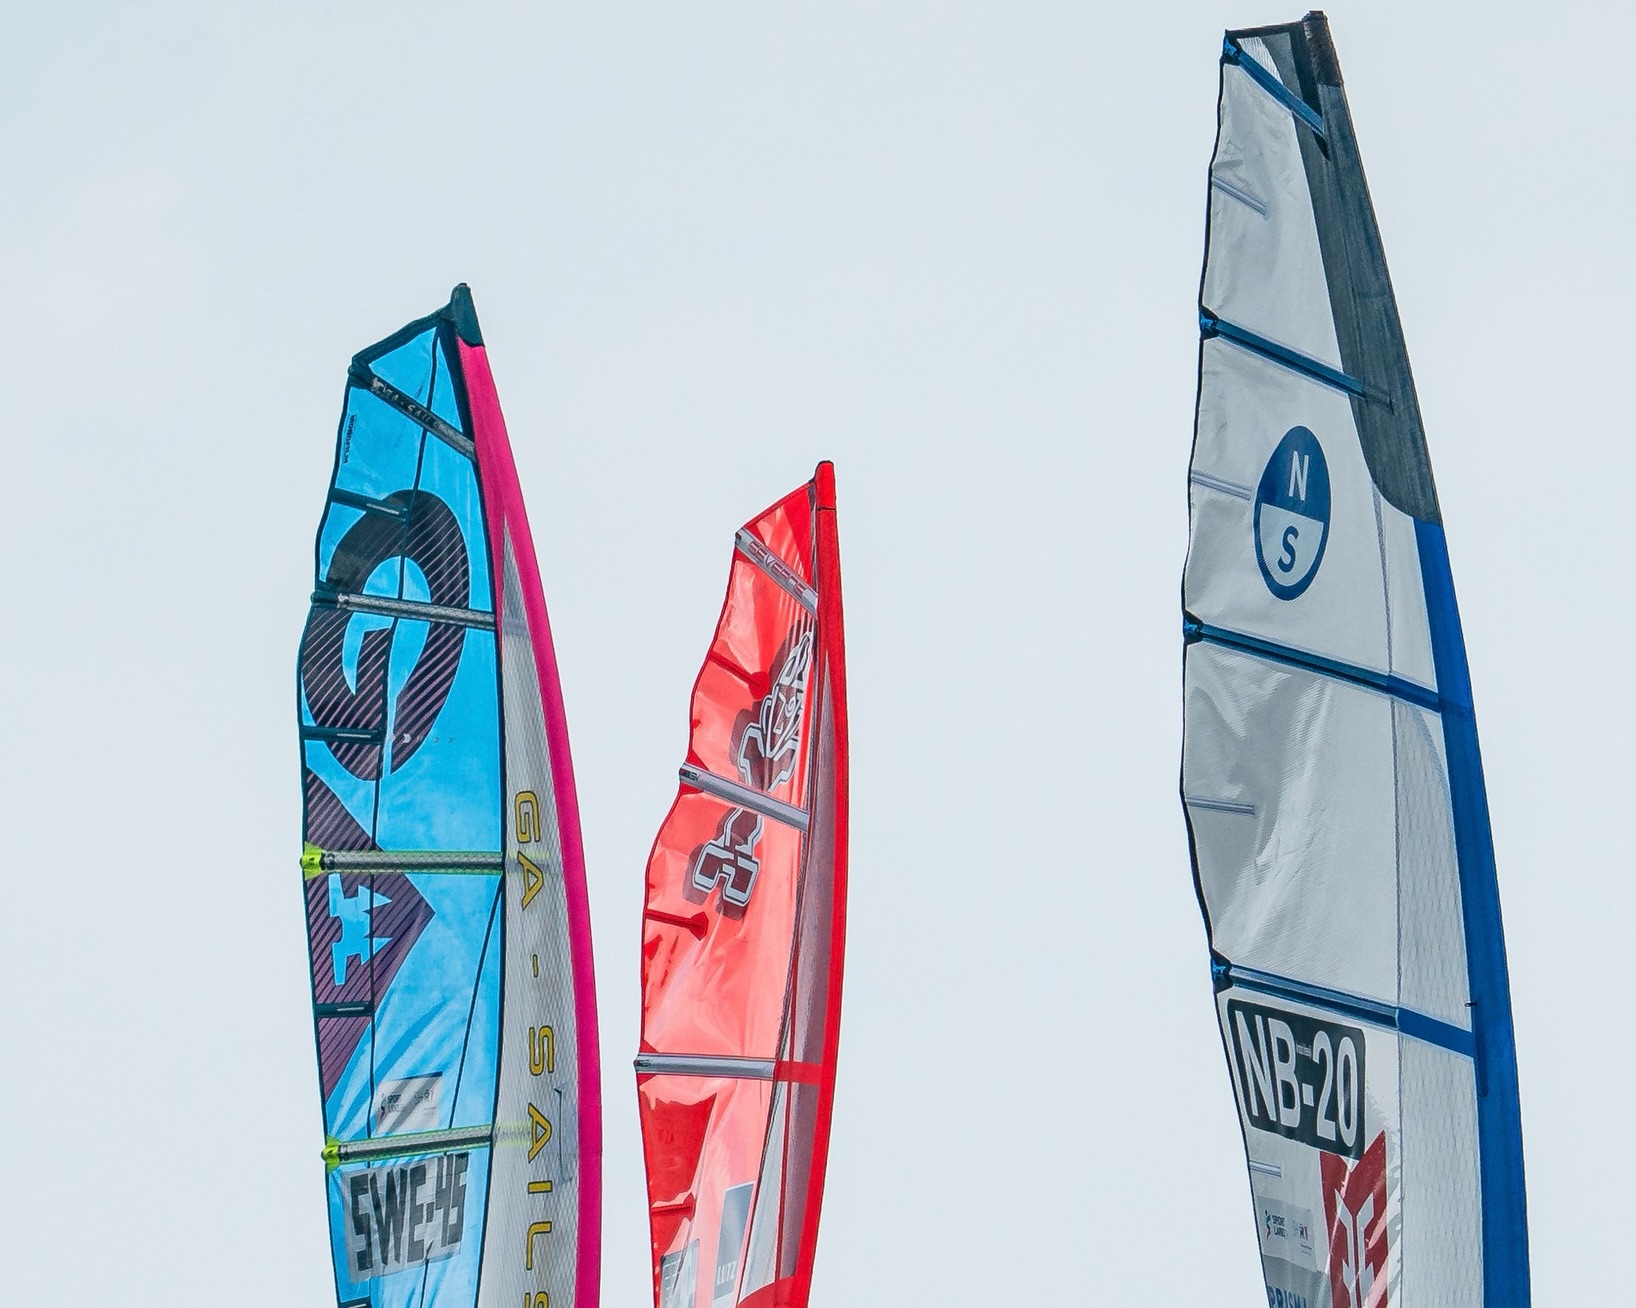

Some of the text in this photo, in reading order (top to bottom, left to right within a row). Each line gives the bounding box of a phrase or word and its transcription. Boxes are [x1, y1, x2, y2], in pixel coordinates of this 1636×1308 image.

[1288, 450, 1309, 501] N
[747, 540, 807, 599] SEVERNE
[1277, 525, 1299, 573] S
[513, 791, 546, 912] GA
[1234, 1010, 1358, 1147] NB-20
[348, 1152, 470, 1271] SWE-45
